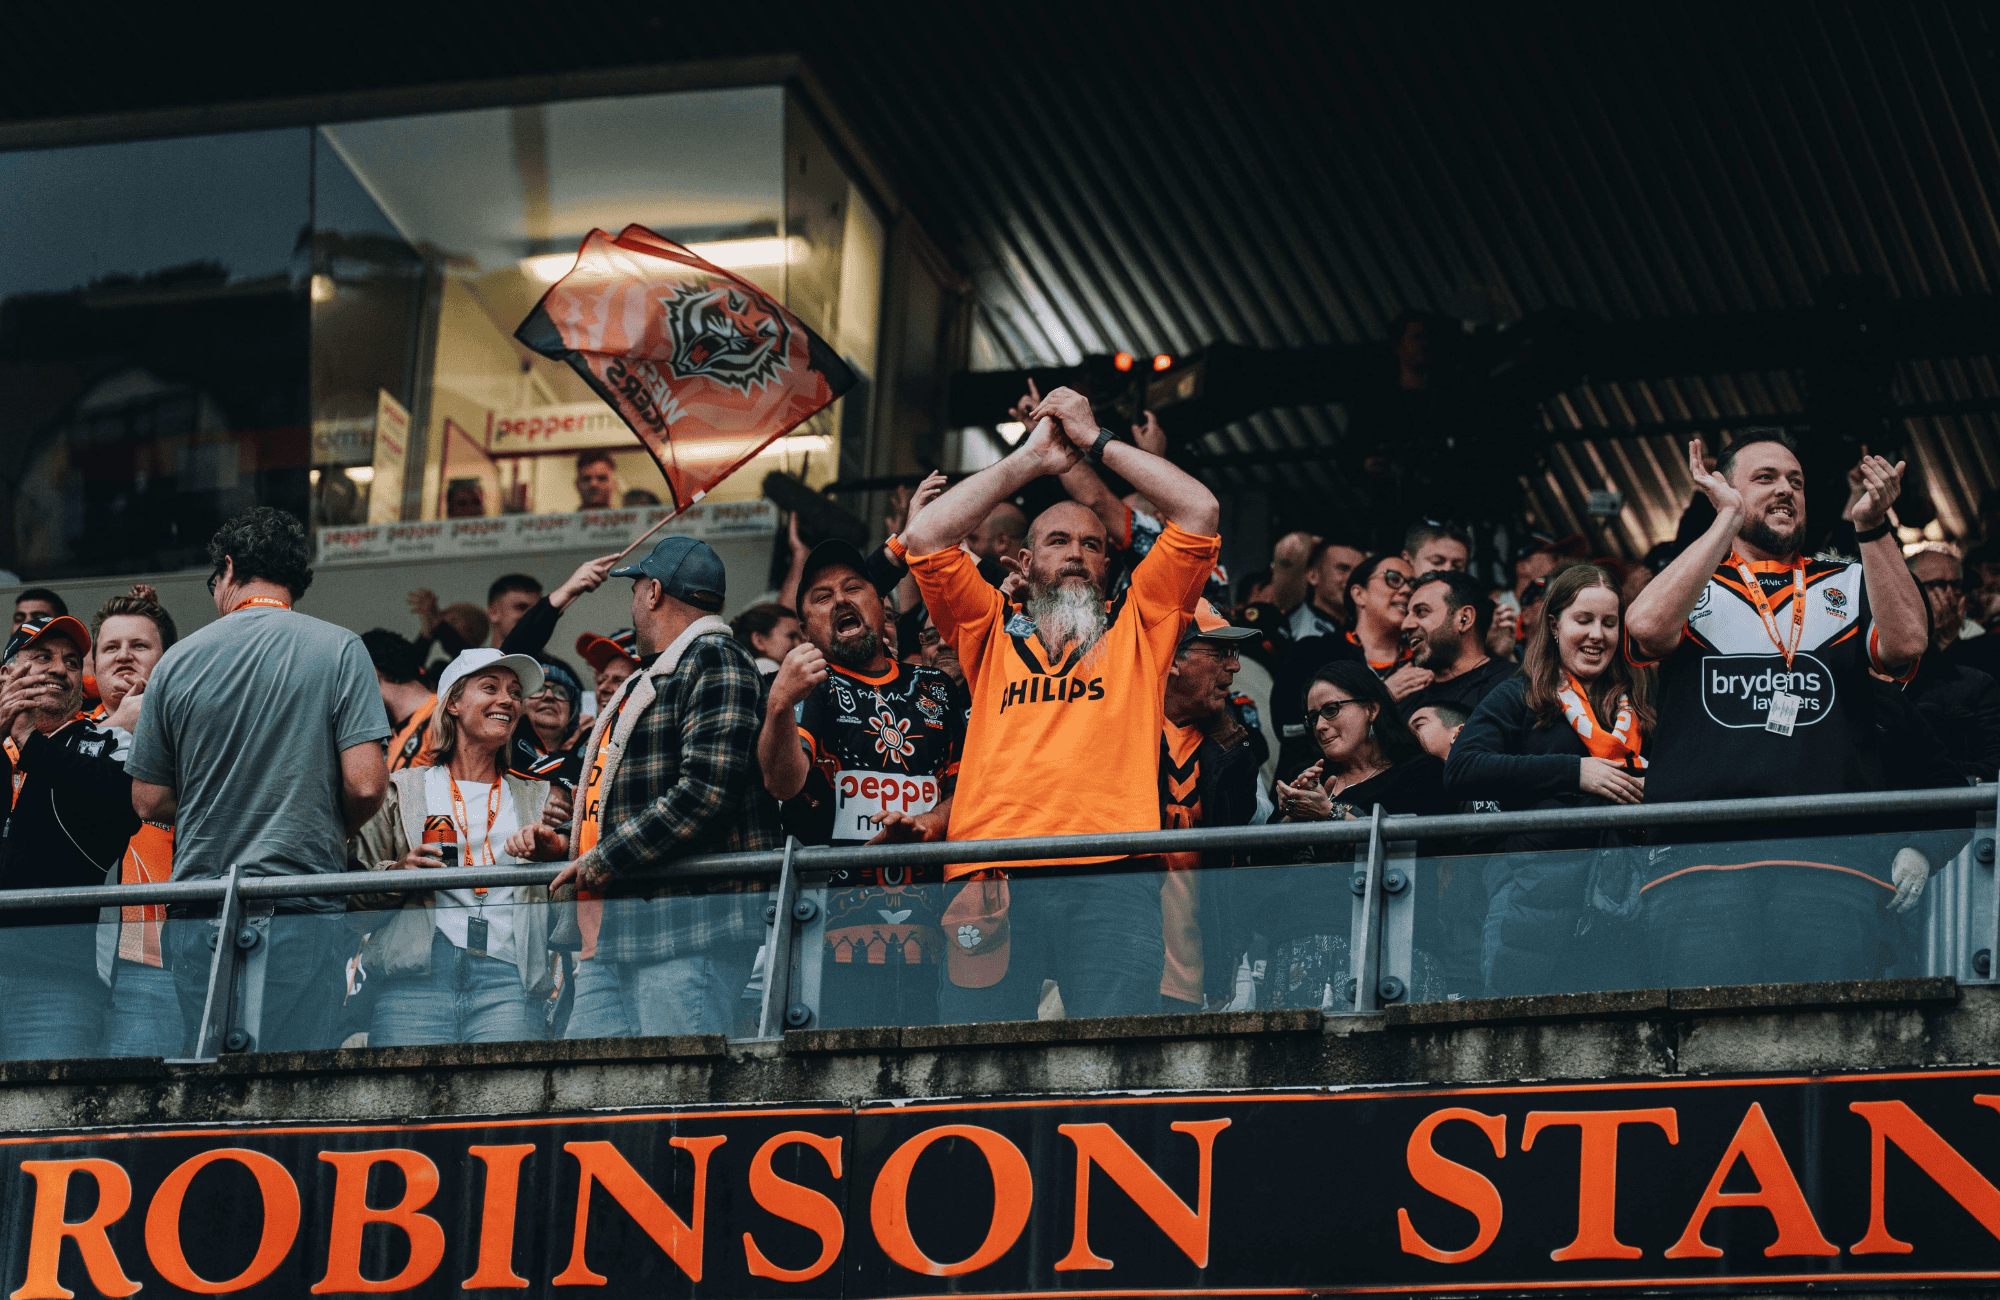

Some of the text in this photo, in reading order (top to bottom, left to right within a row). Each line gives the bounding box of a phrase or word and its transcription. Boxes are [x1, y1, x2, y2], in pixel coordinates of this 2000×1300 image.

[1825, 606, 1848, 617] WESTS
[1712, 668, 1821, 699] brydens
[840, 775, 935, 812] peppe
[10, 1117, 1232, 1299] ROBINSON
